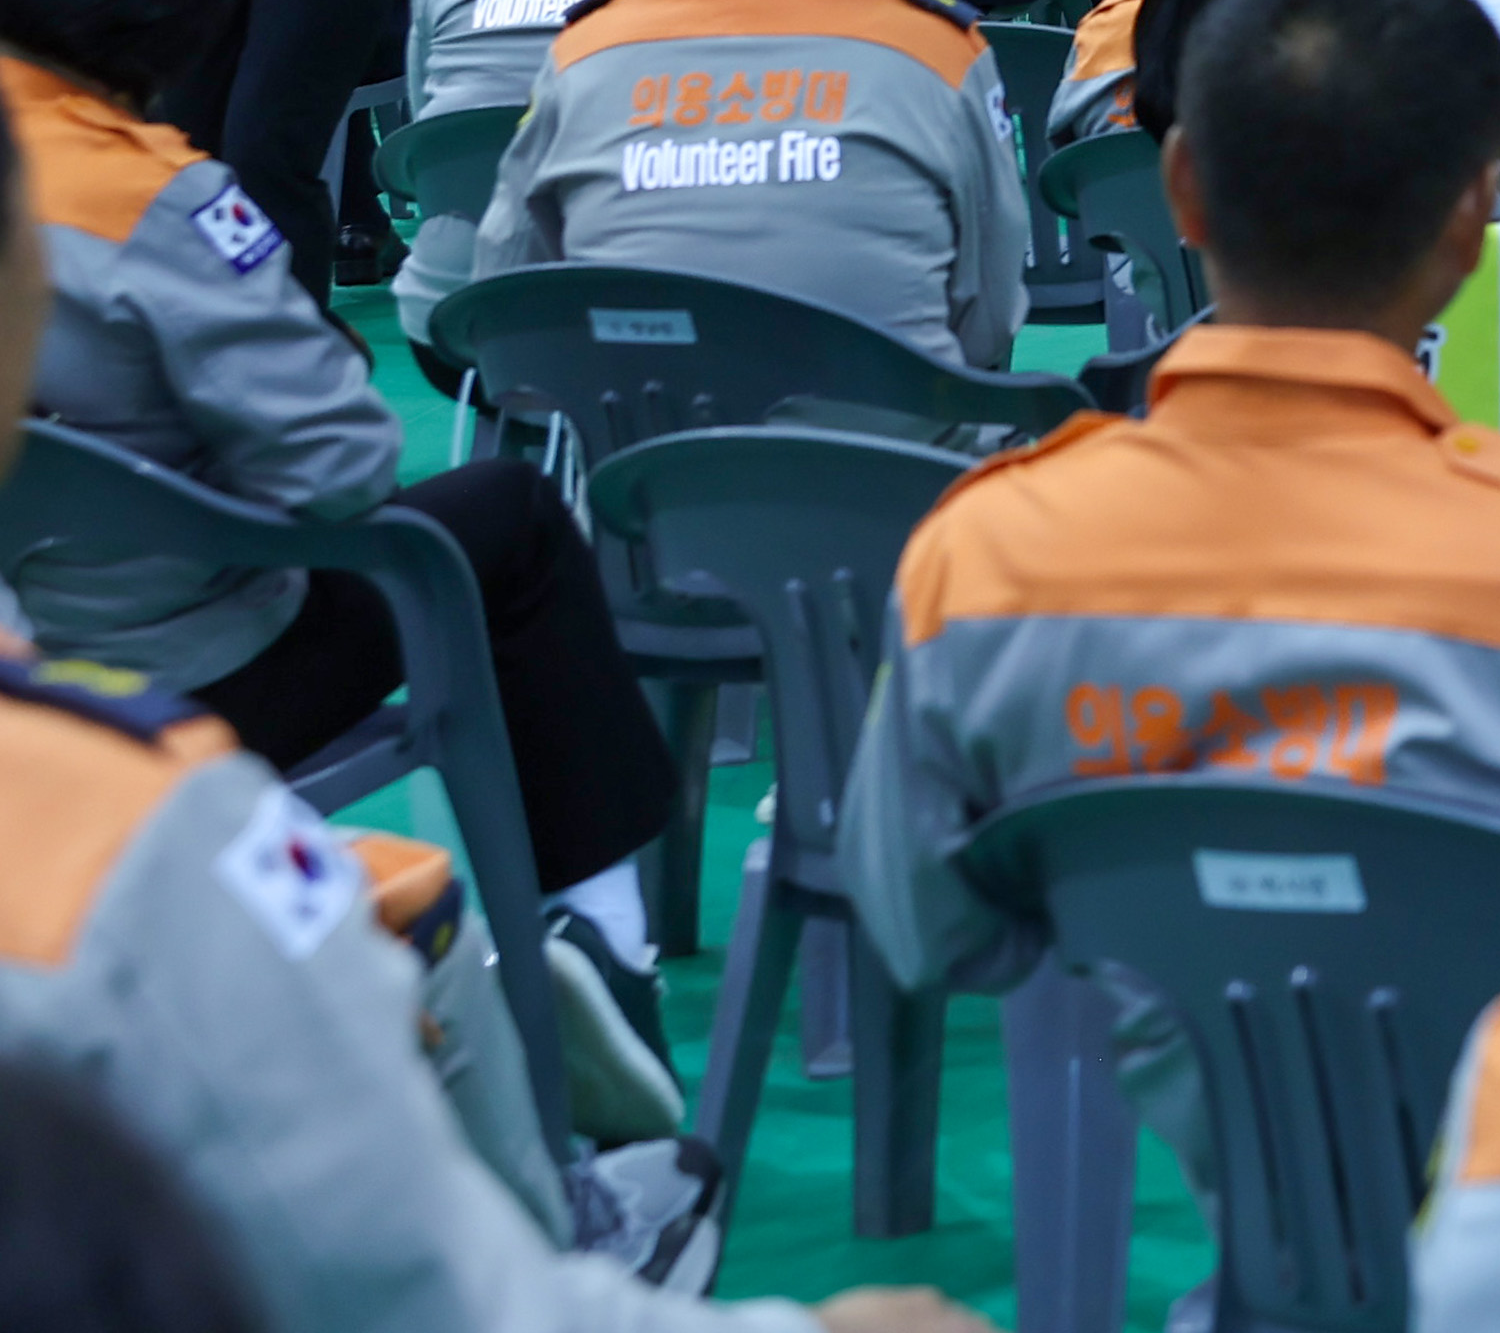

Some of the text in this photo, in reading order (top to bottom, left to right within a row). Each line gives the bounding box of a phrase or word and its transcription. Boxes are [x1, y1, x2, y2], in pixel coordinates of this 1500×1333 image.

[628, 68, 849, 127] 의용소방대
[622, 130, 842, 191] Volunteer Fire
